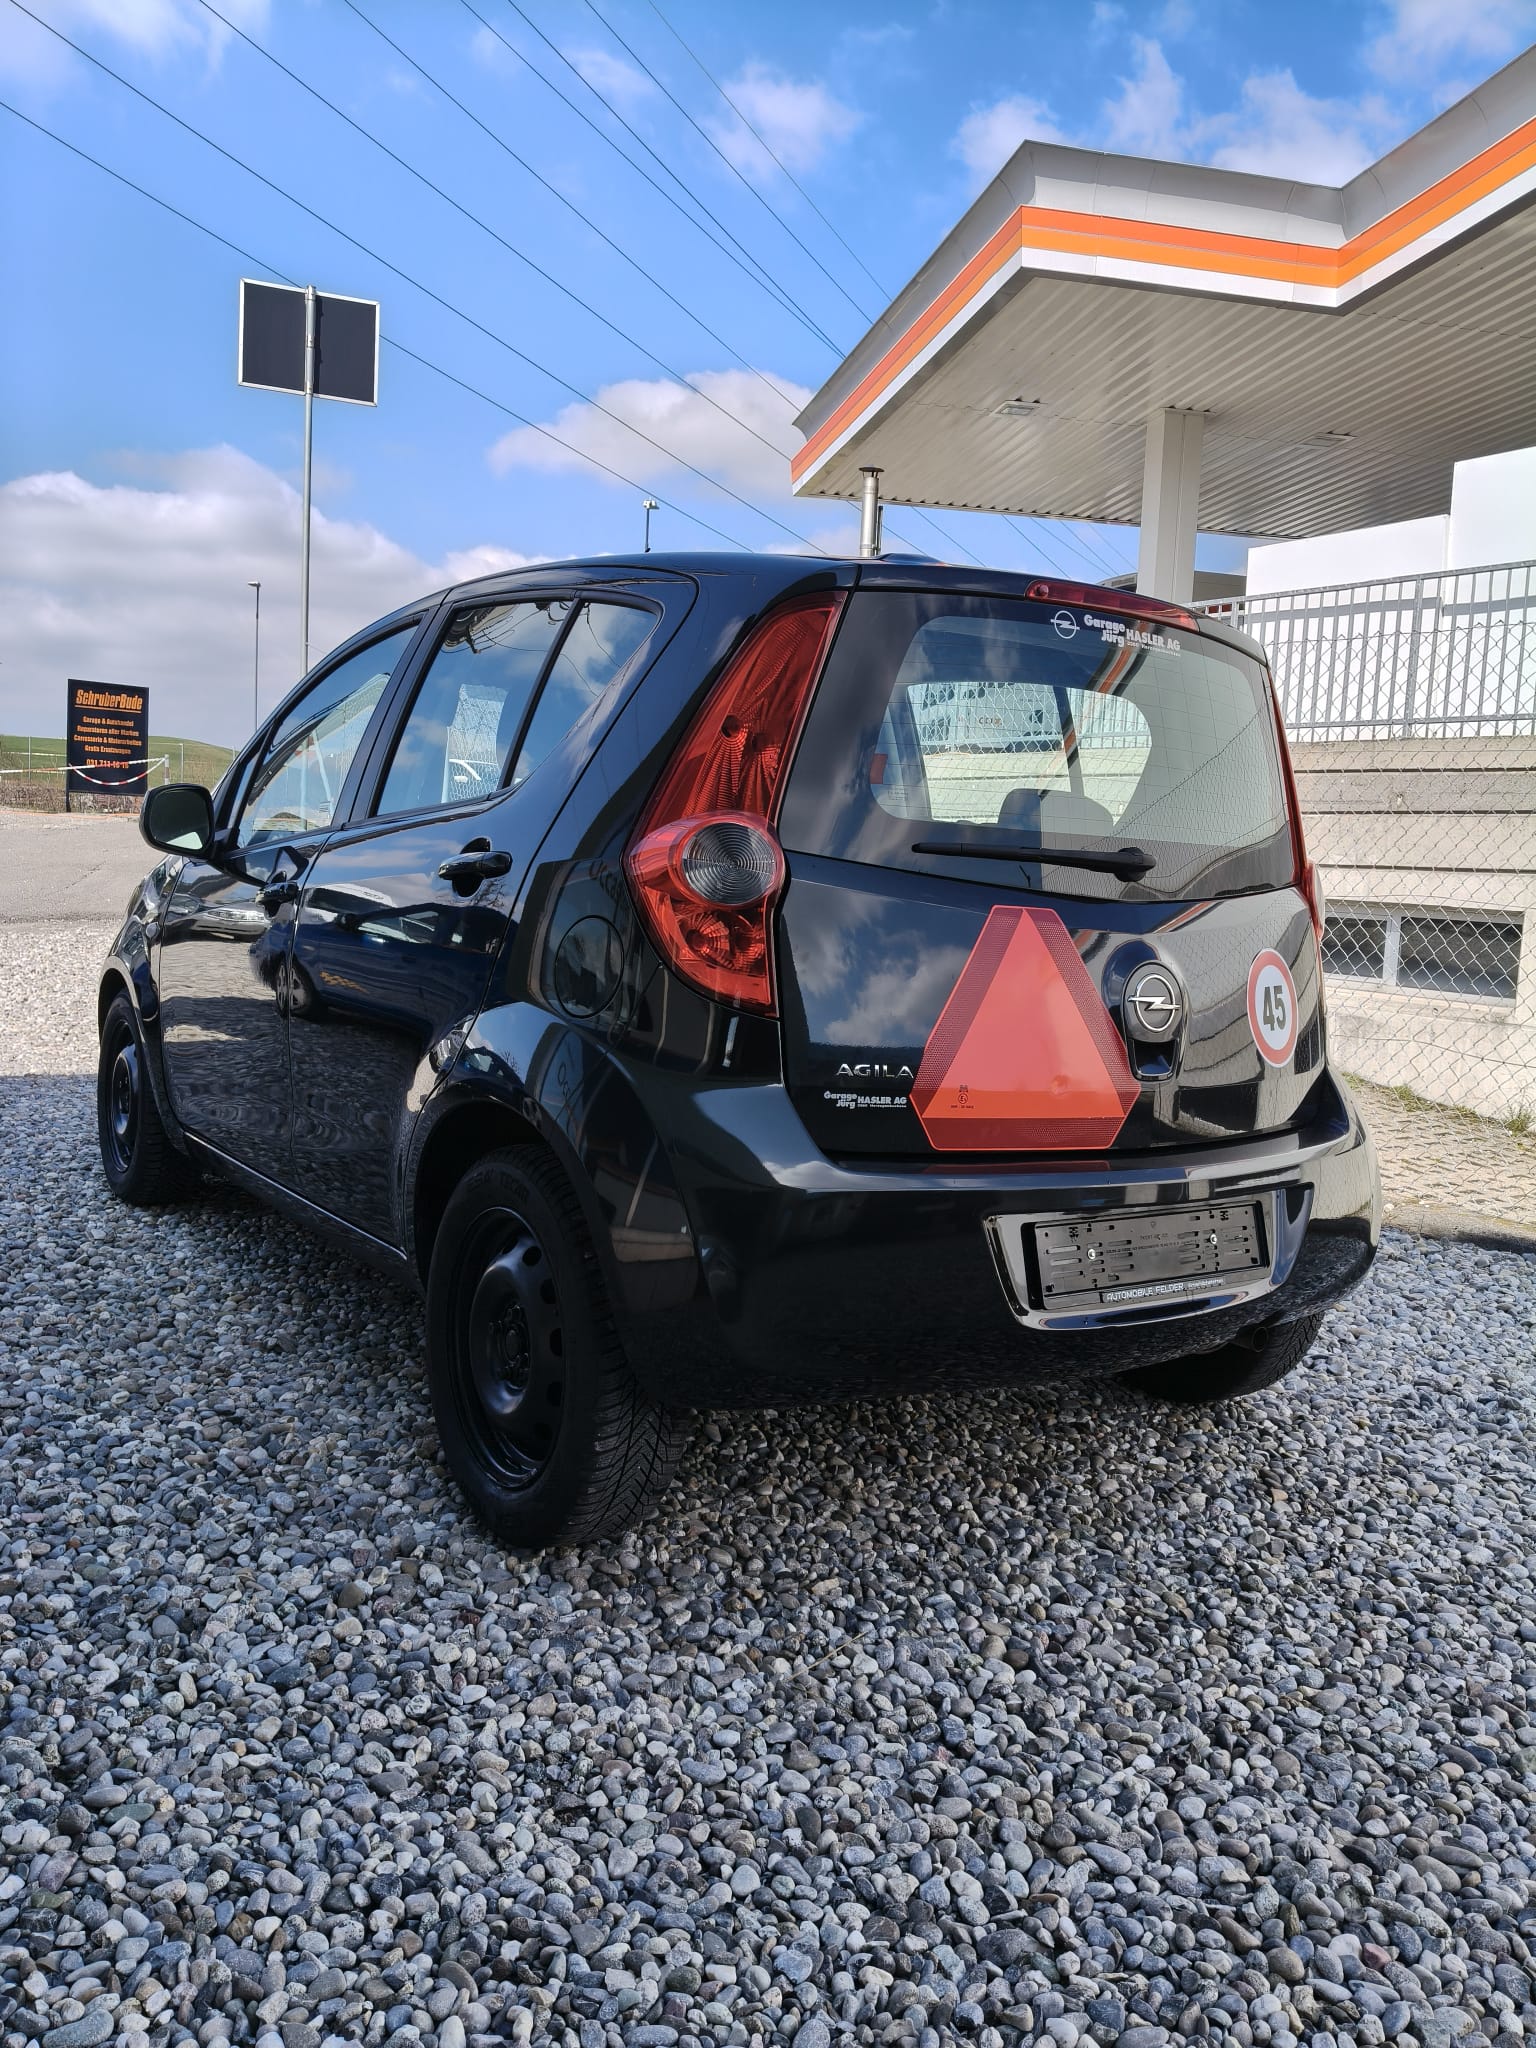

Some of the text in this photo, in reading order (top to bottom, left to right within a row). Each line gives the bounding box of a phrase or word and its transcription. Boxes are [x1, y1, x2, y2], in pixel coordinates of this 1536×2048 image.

[1084, 614, 1126, 633] Garage
[1101, 629, 1125, 647] Jürg
[1126, 629, 1164, 648] HASLER
[1166, 637, 1181, 651] AG
[1262, 984, 1287, 1032] 45
[835, 1063, 914, 1079] AGILA
[823, 1090, 857, 1102] Garage
[836, 1099, 856, 1109] Jürg
[857, 1096, 892, 1104] HASLER
[893, 1096, 907, 1104] AG
[1106, 1287, 1154, 1301] AUTOMOBILE
[1155, 1283, 1184, 1295] FELDER
